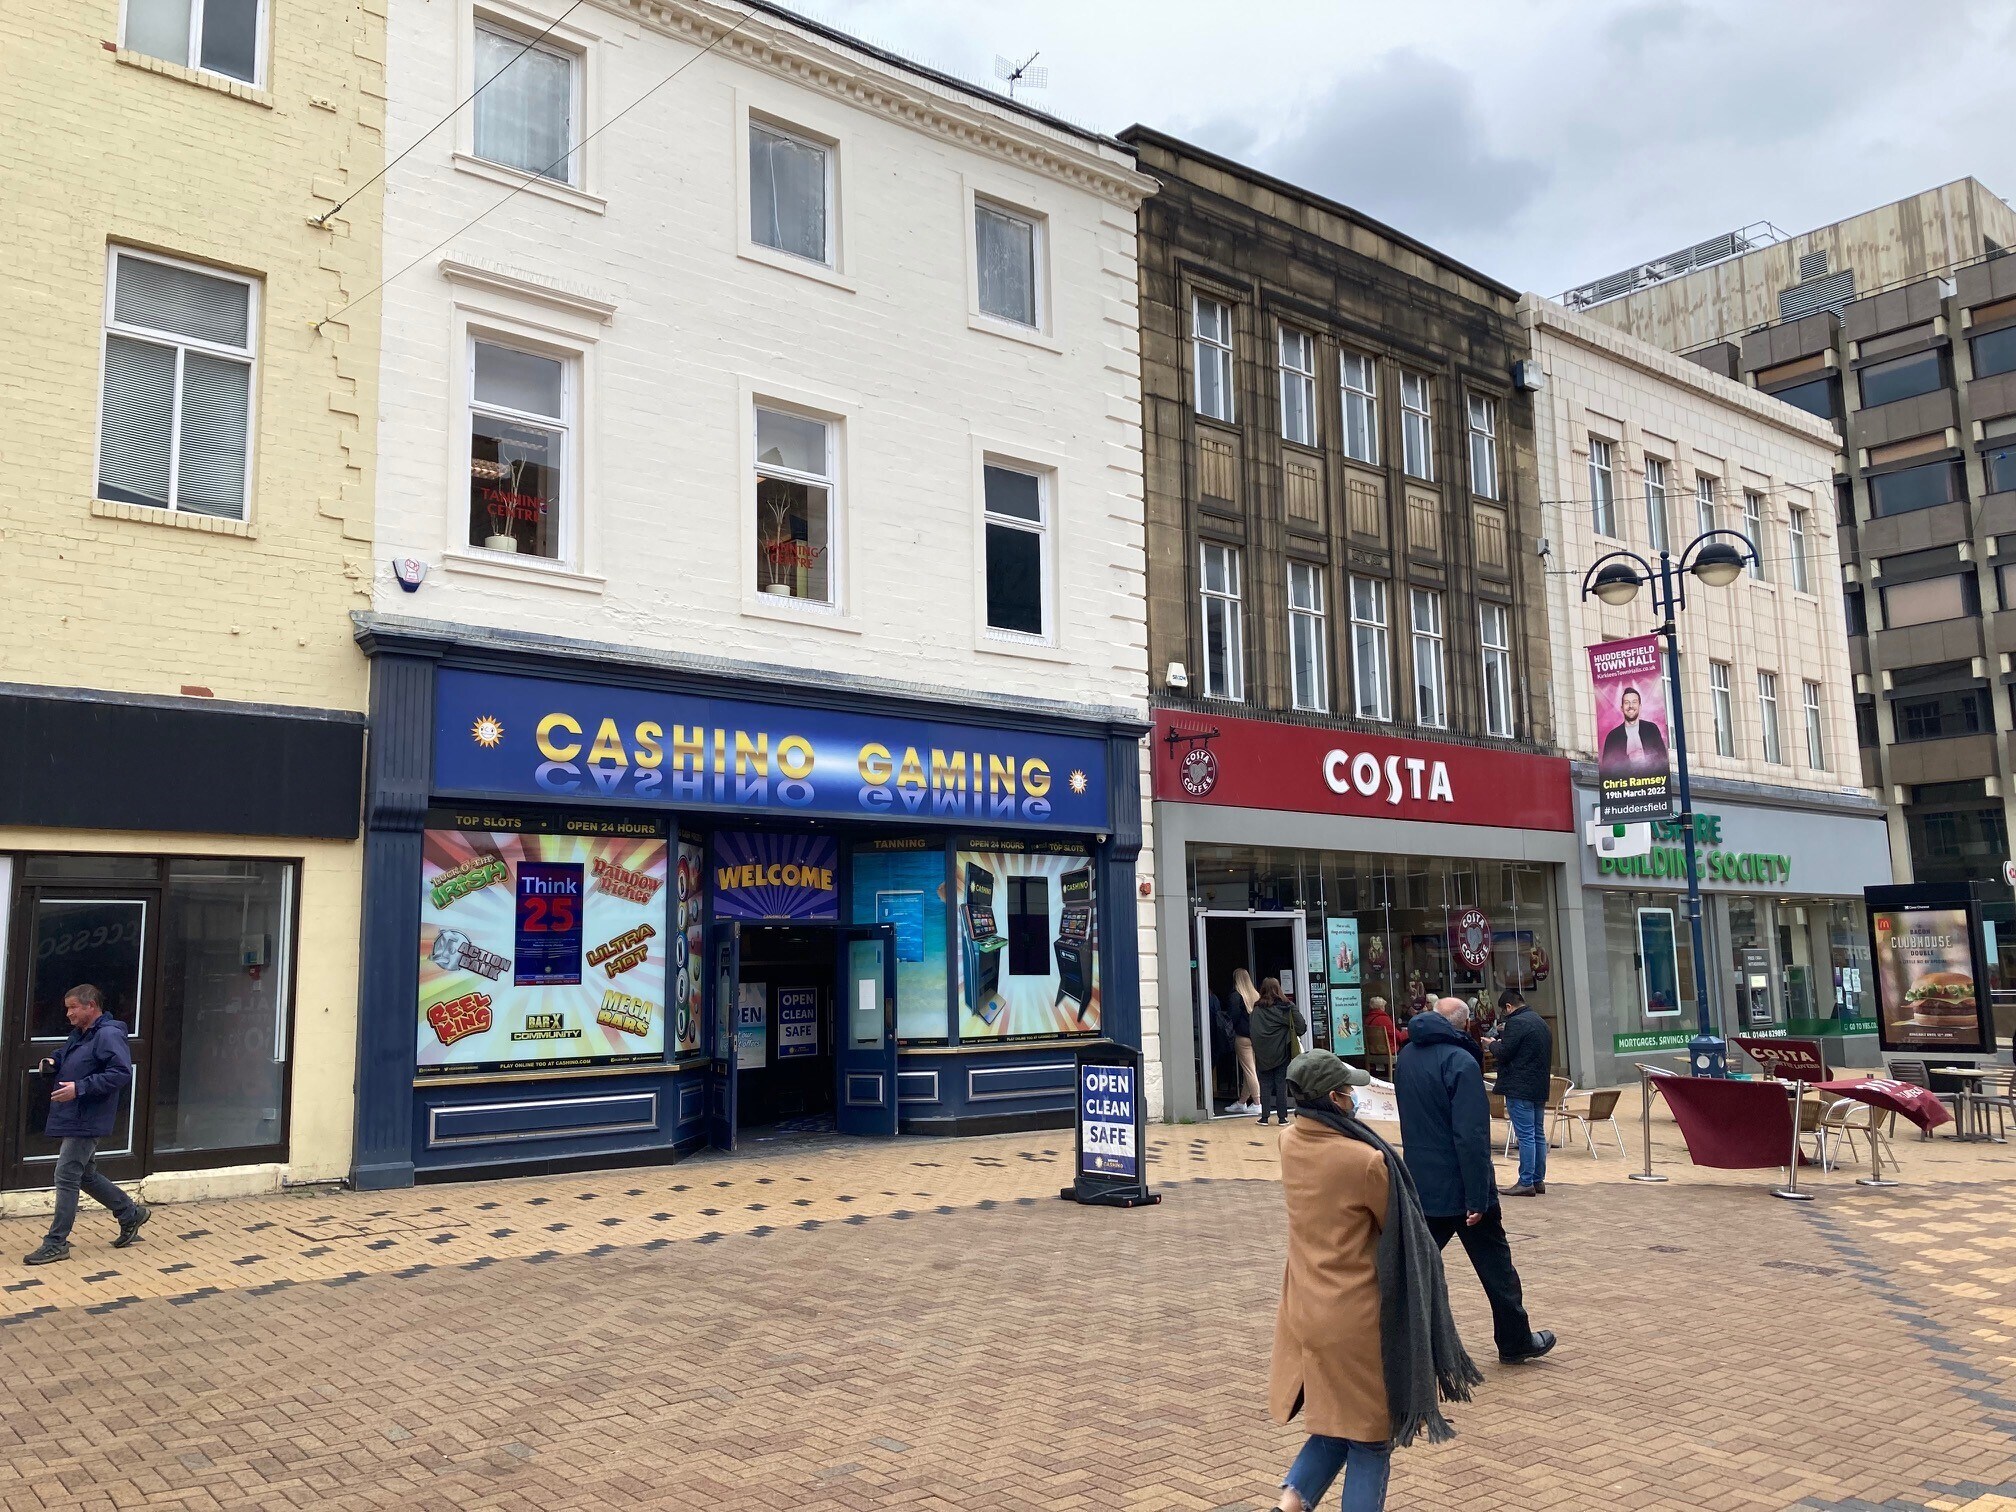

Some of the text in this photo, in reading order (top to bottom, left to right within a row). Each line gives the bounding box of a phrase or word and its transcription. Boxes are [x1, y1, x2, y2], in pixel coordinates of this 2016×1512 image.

[1593, 645, 1655, 663] HUDDERSFIELD
[1594, 653, 1656, 673] TOWN HALL
[535, 712, 1051, 798] CASHINO GAMING
[1185, 751, 1210, 766] COSTA
[1184, 775, 1213, 793] COFFEE
[1323, 748, 1455, 805] COSTA
[1603, 775, 1667, 790] Chris Ramsey
[1605, 786, 1666, 800] 19th March 2022
[1603, 801, 1668, 815] #huddersfield
[455, 815, 522, 828] TOP SLOTS
[566, 820, 656, 834] OPEN 24 HOURS
[873, 839, 926, 849] TANNING
[969, 839, 1025, 850] OPEN 24 HOURS
[1049, 843, 1085, 852] TOP SLOTS
[592, 857, 663, 892] Rainbow
[1709, 850, 1792, 882] SOCIETY
[521, 876, 577, 894] Think
[717, 863, 834, 891] WELCOME
[1066, 880, 1089, 892] CASHINO
[600, 876, 651, 904] Riches
[523, 897, 574, 932] 25
[1462, 912, 1485, 929] COSTA
[586, 923, 656, 967] ULTRA
[1891, 935, 1953, 949] CLUBHOUSE
[457, 941, 512, 972] ACTION
[604, 943, 649, 979] HOT
[1461, 942, 1489, 964] COFFEE
[458, 955, 502, 981] BANK
[428, 992, 492, 1025] REEL
[602, 989, 653, 1023] MEGA
[782, 993, 814, 1006] OPEN
[528, 1013, 562, 1030] BAR-X
[597, 1010, 649, 1037] BARS
[782, 1009, 814, 1020] CLEAN
[434, 1007, 491, 1044] KING
[785, 1025, 812, 1037] SAFE
[513, 1030, 580, 1041] COMMUNITY
[1659, 1034, 1684, 1045] SAVINGS
[1684, 1034, 1690, 1043] &
[1750, 1047, 1815, 1062] COSTA
[1086, 1073, 1129, 1094] OPEN
[1086, 1098, 1130, 1117] CLEAN
[1090, 1125, 1127, 1146] SAFE
